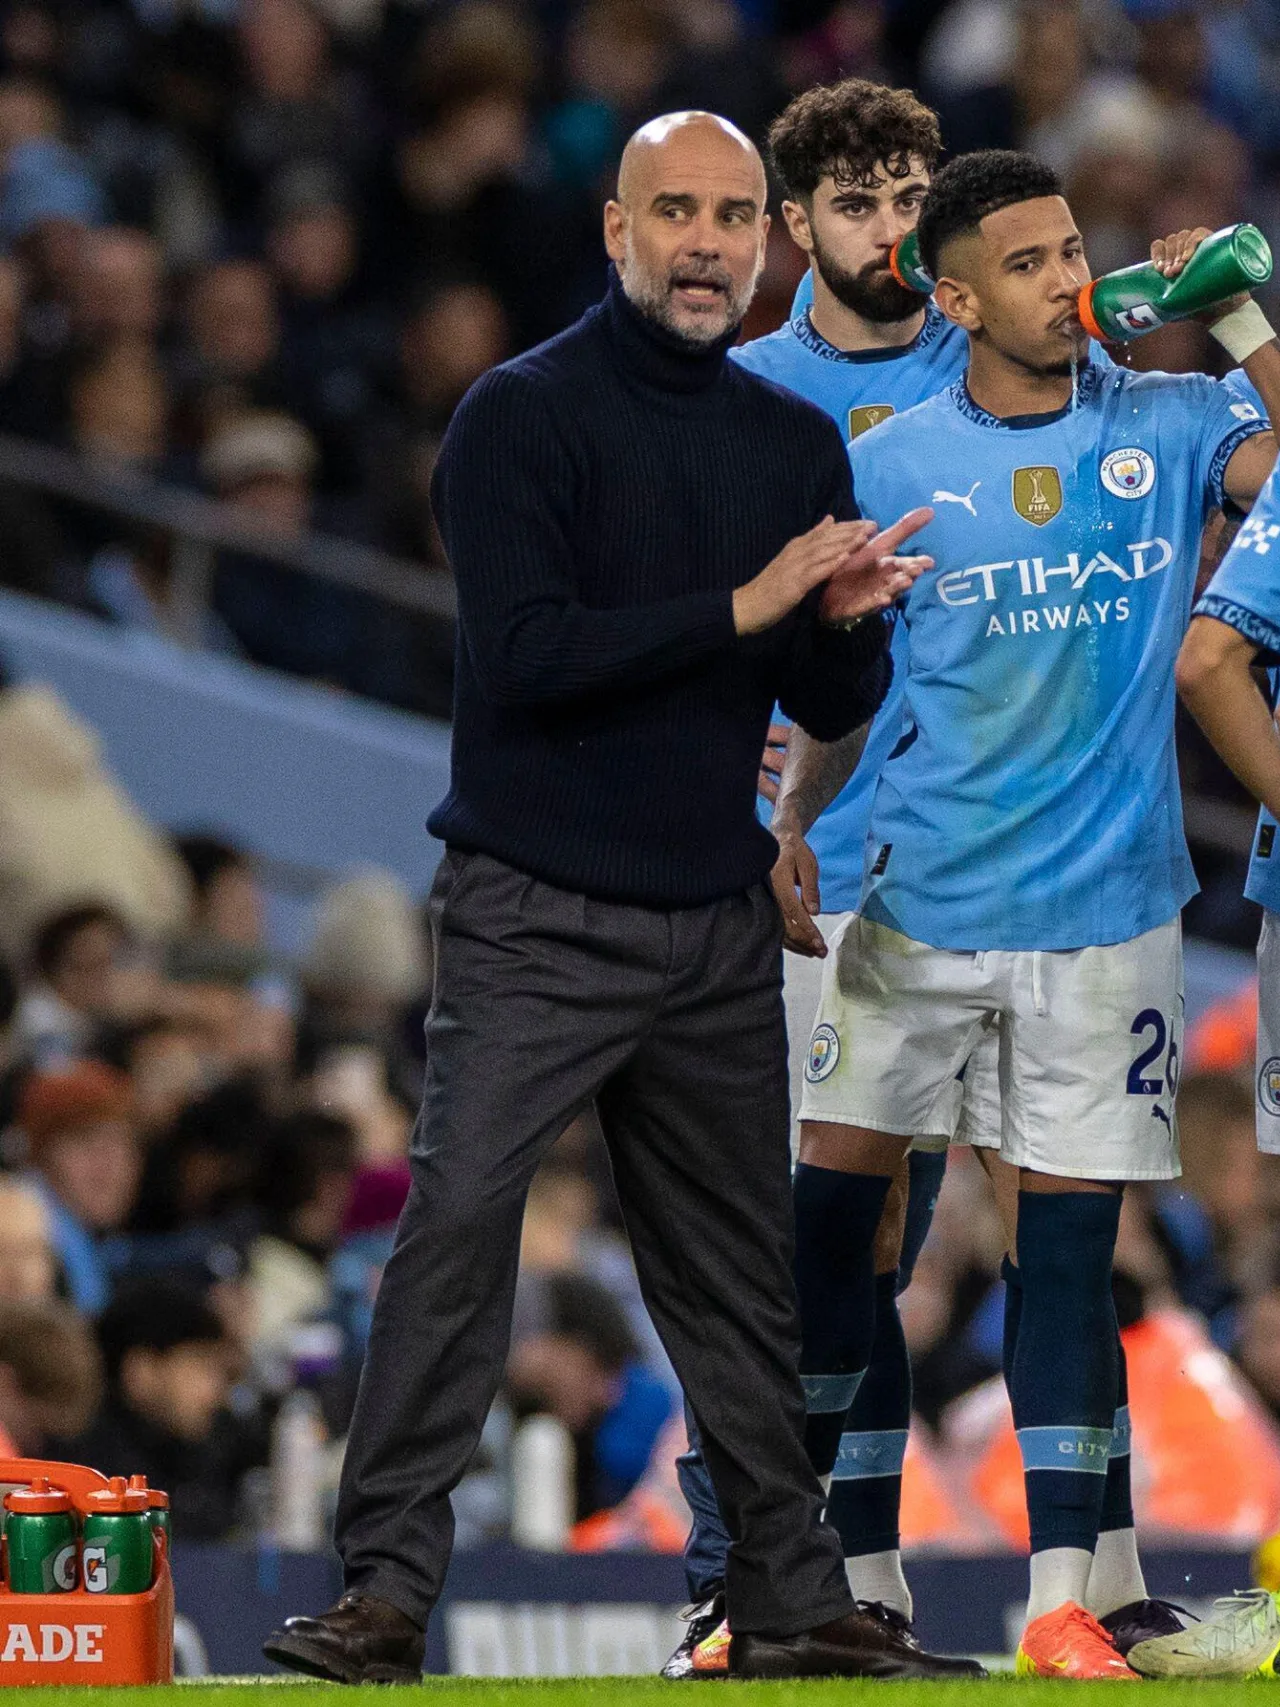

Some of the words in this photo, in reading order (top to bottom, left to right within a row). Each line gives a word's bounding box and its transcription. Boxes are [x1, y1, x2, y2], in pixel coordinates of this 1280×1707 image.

[1103, 450, 1148, 473] MANCHESTER
[1028, 503, 1052, 513] FIFA
[1125, 488, 1144, 499] CITY
[936, 536, 1174, 607] ETIHAD
[985, 596, 1131, 638] AIRWAYS
[1126, 1008, 1179, 1098] 26
[82, 1546, 109, 1593] G
[1, 1624, 104, 1663] ADE
